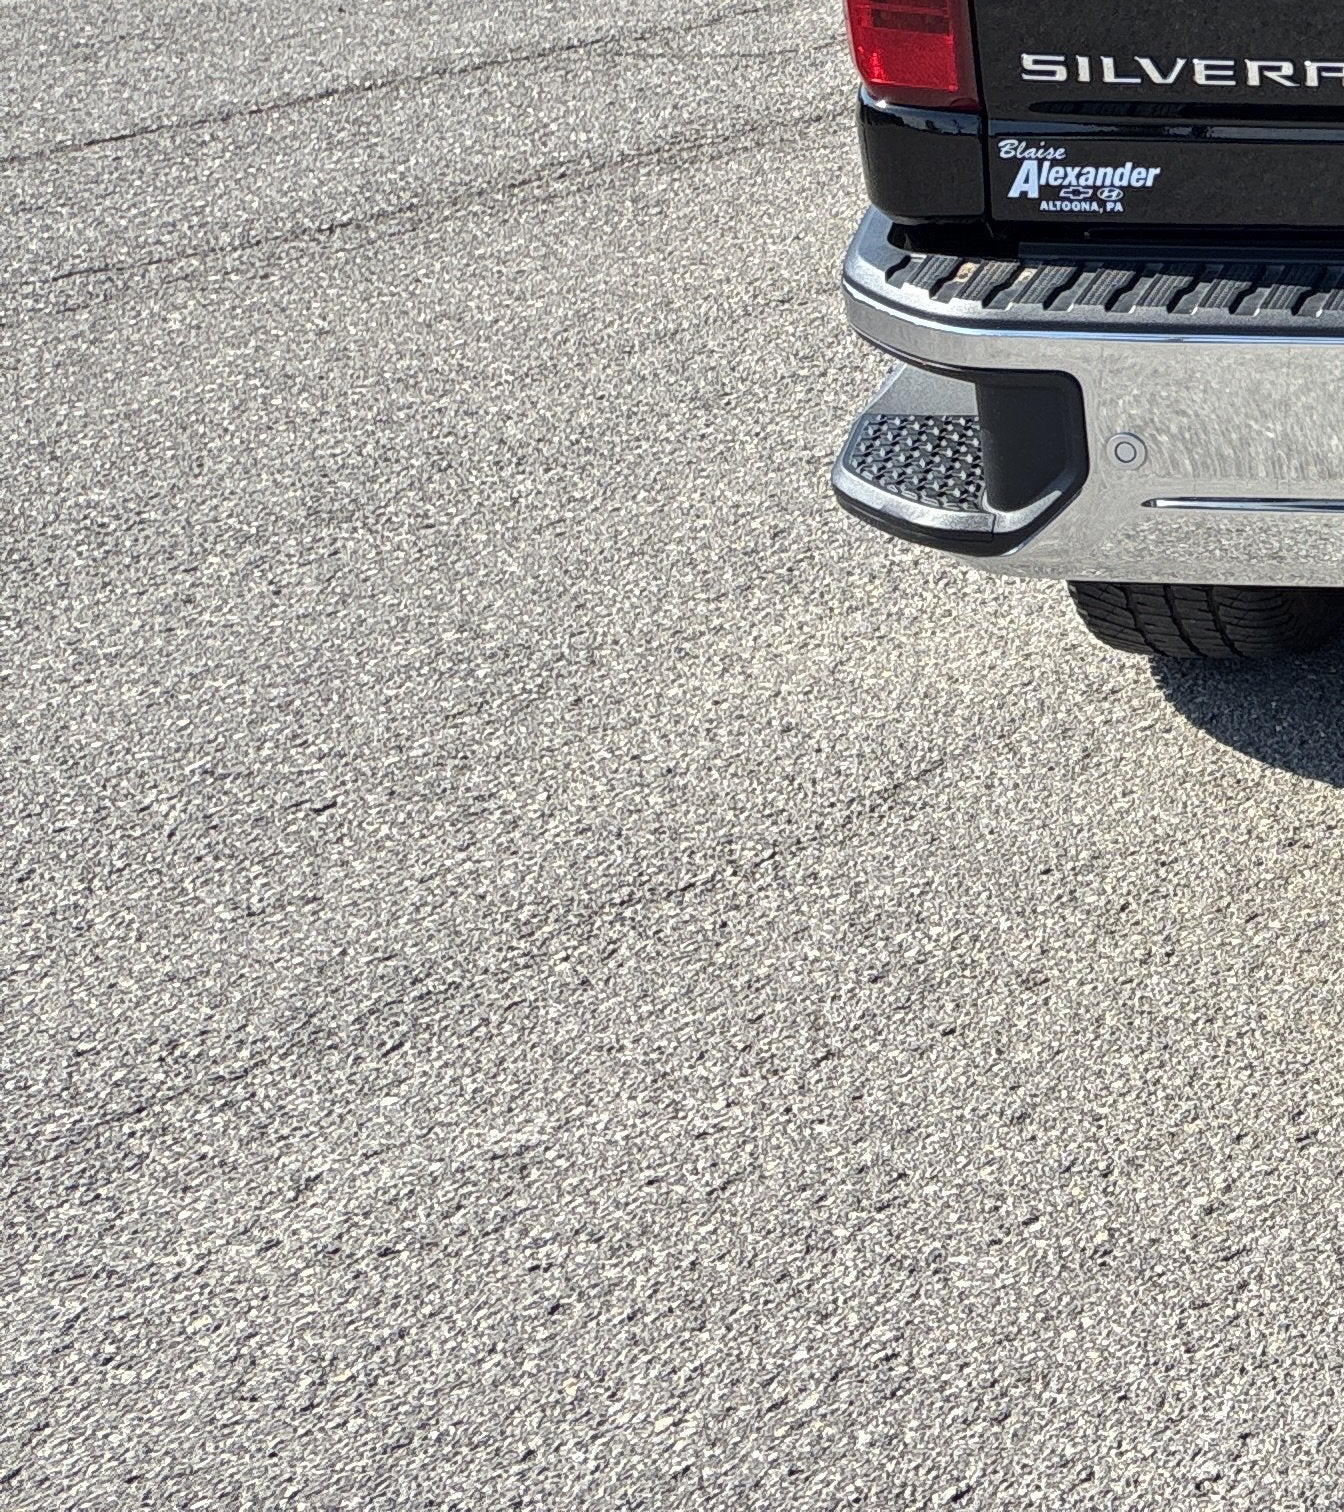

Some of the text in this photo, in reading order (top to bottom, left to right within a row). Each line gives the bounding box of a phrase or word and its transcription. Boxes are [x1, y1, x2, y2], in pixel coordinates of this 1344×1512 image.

[998, 139, 1066, 160] Blaise
[1007, 159, 1160, 199] Alexander
[1039, 201, 1124, 214] ALTOONA, PA
